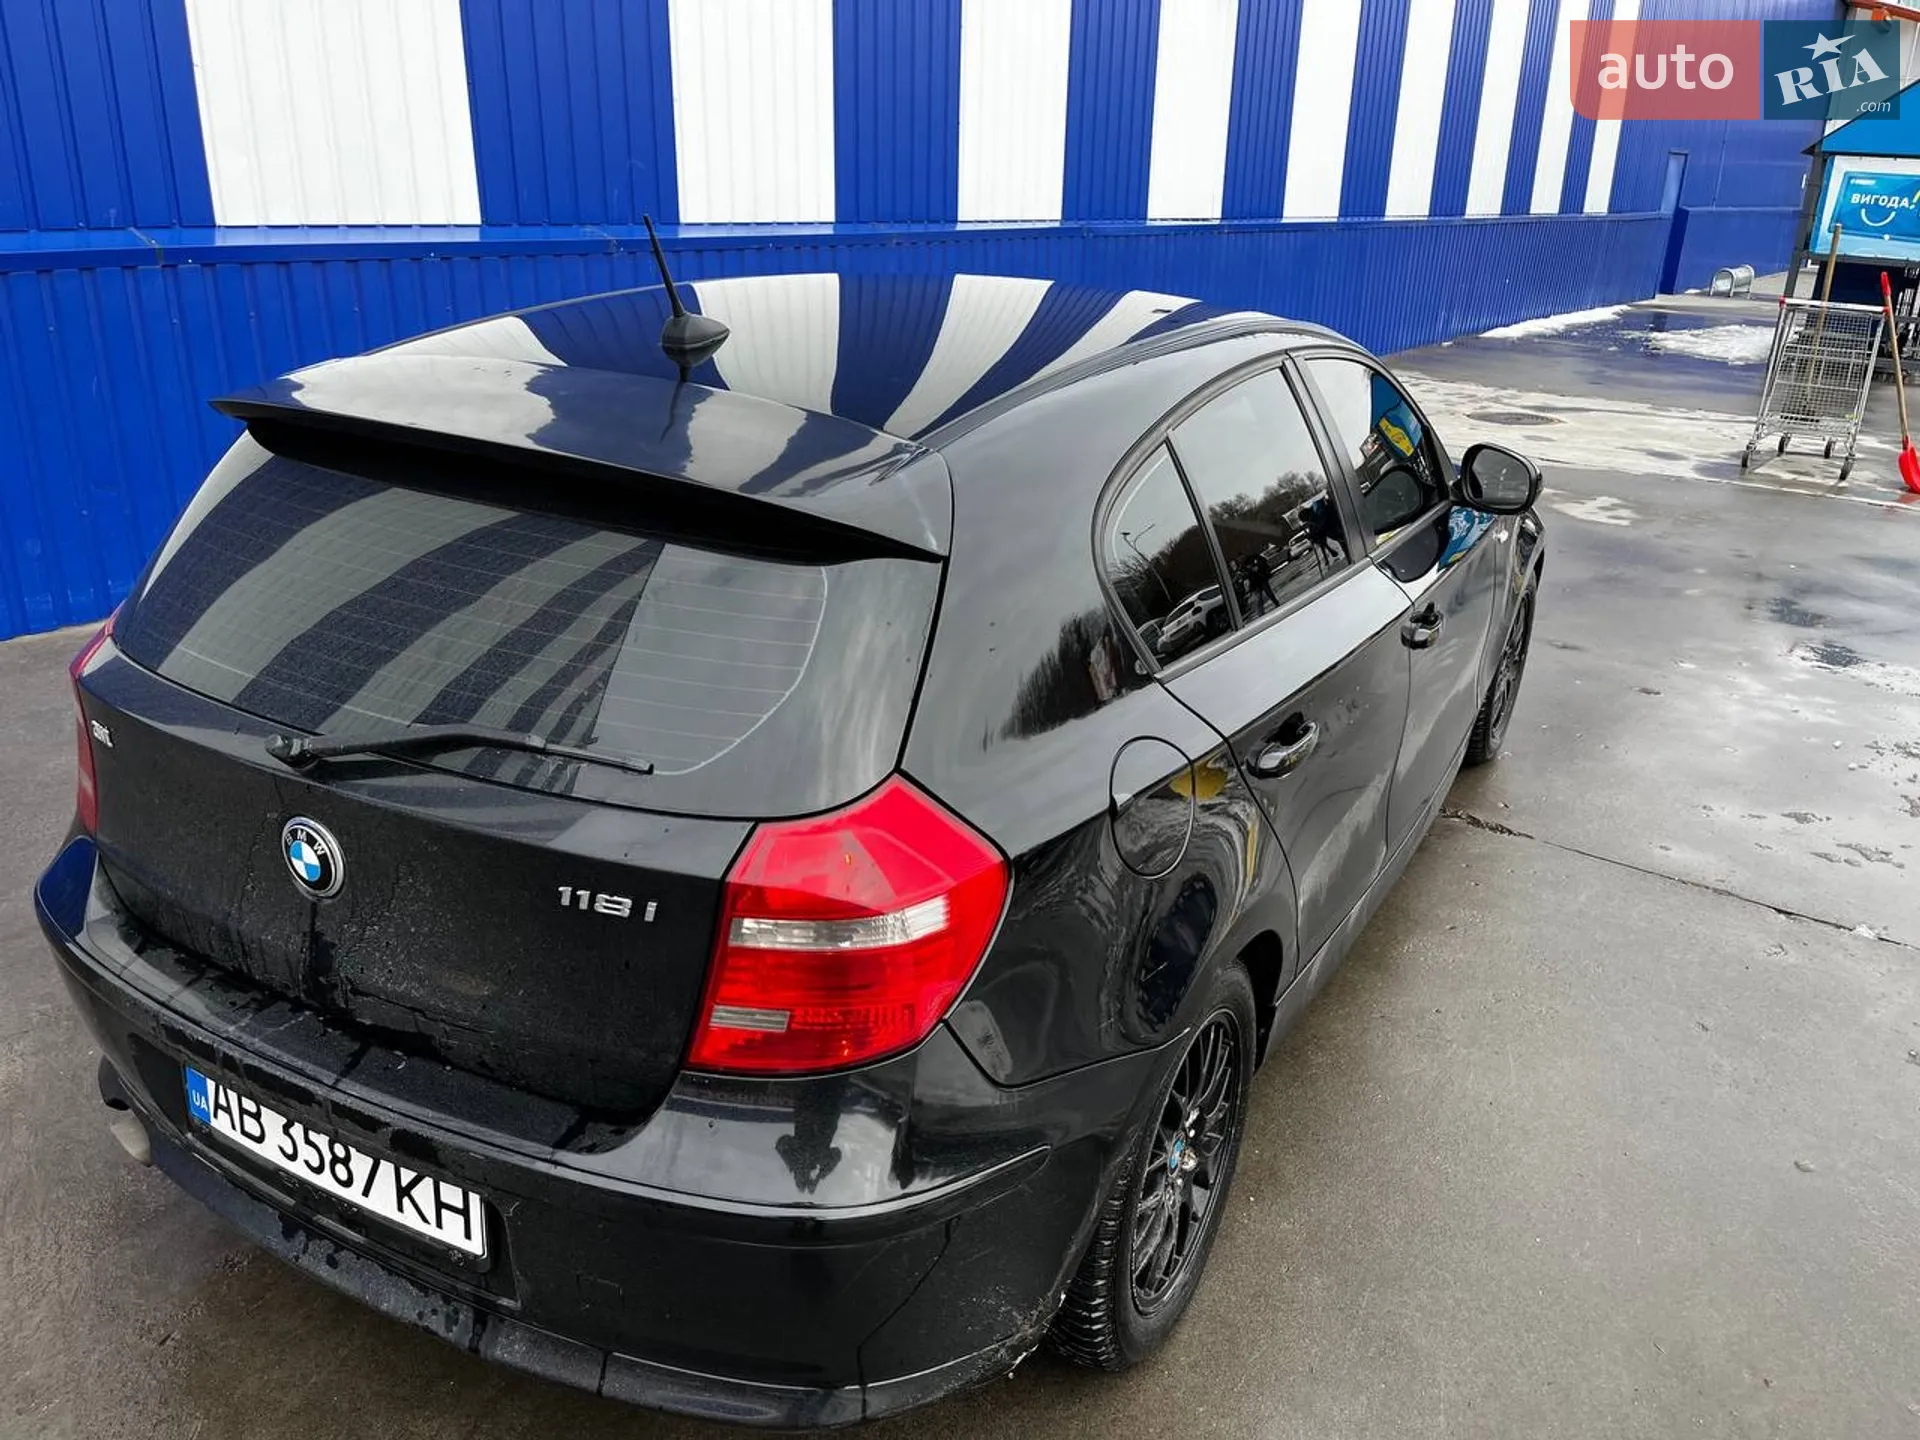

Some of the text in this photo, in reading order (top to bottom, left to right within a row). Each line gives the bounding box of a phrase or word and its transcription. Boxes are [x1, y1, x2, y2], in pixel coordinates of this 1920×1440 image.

[1850, 189, 1920, 210] ВИГОДА!
[285, 829, 326, 856] BMW
[192, 1089, 209, 1112] UA
[213, 1083, 266, 1145] AB
[394, 1163, 472, 1241] KH
